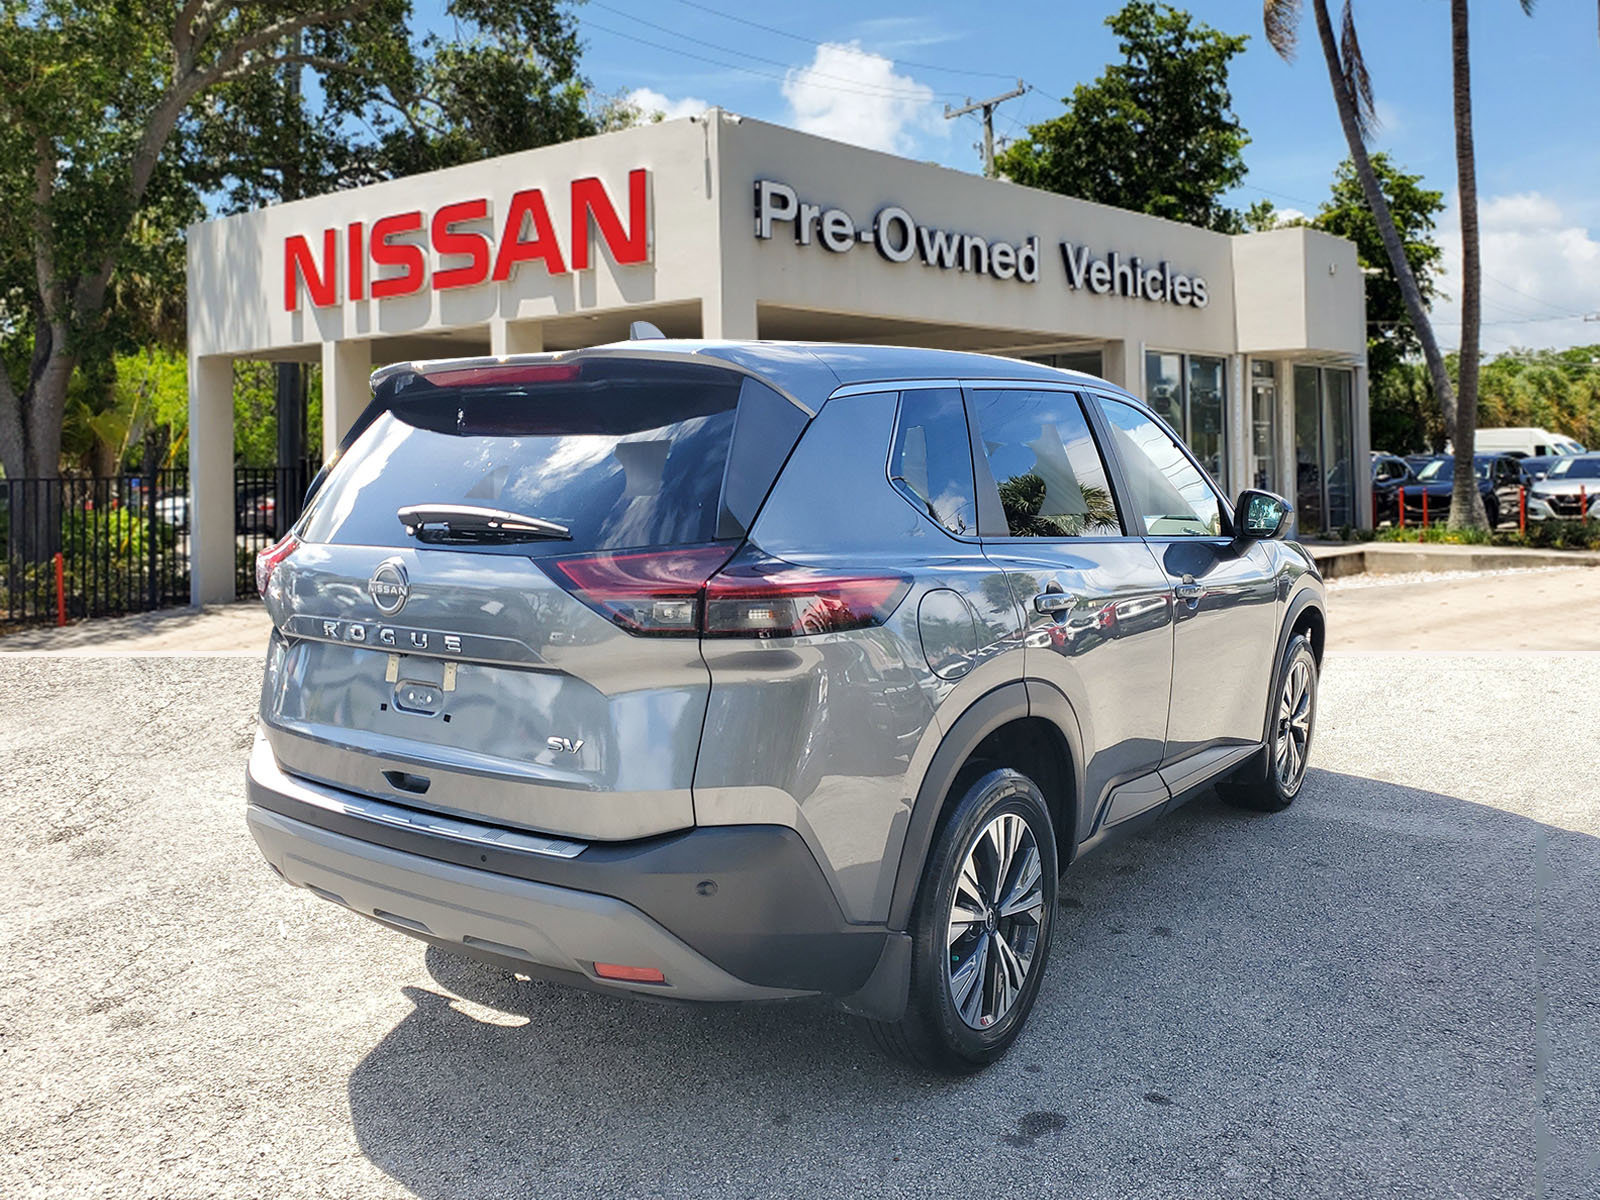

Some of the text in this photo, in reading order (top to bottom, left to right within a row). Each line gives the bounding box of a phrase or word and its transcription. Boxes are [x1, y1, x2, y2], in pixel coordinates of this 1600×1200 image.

[285, 168, 648, 311] NISSAN
[755, 180, 1209, 308] Pre-Owned Vehicles
[368, 583, 407, 596] NISSAN
[323, 620, 463, 653] ROGUE
[547, 736, 585, 754] SV
